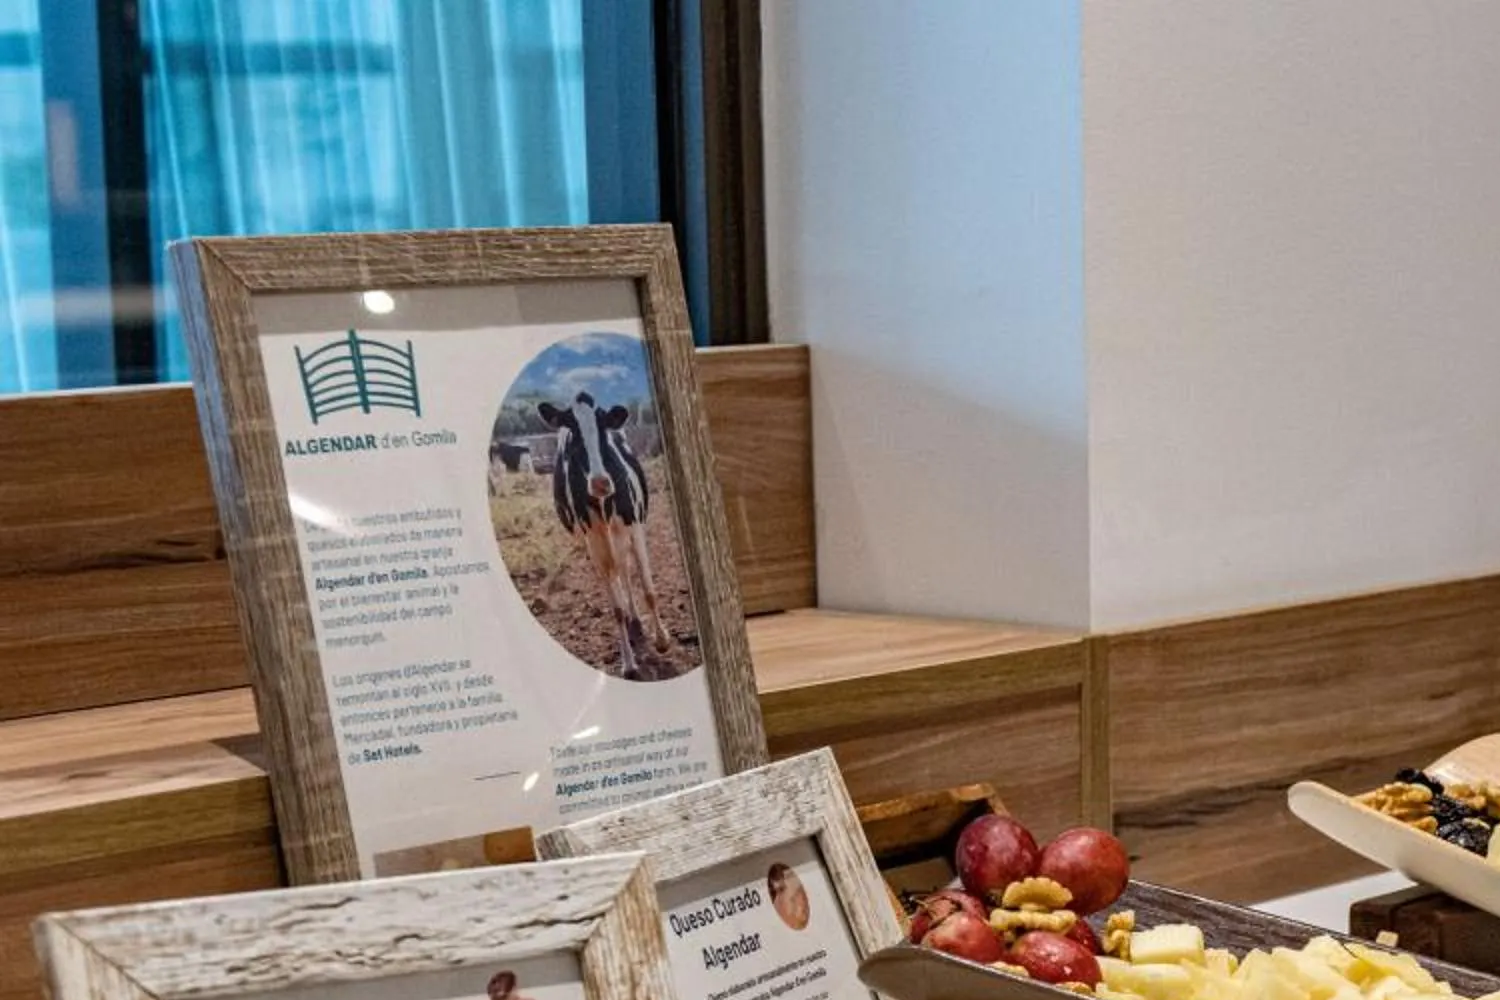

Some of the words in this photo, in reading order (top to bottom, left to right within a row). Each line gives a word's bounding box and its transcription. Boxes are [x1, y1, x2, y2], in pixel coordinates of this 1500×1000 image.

[285, 434, 378, 456] ALGENDAR
[412, 428, 457, 447] Gomila
[316, 575, 366, 592] Algendar
[669, 906, 714, 938] Queso
[713, 888, 761, 919] Curado
[702, 932, 762, 970] Algendar
